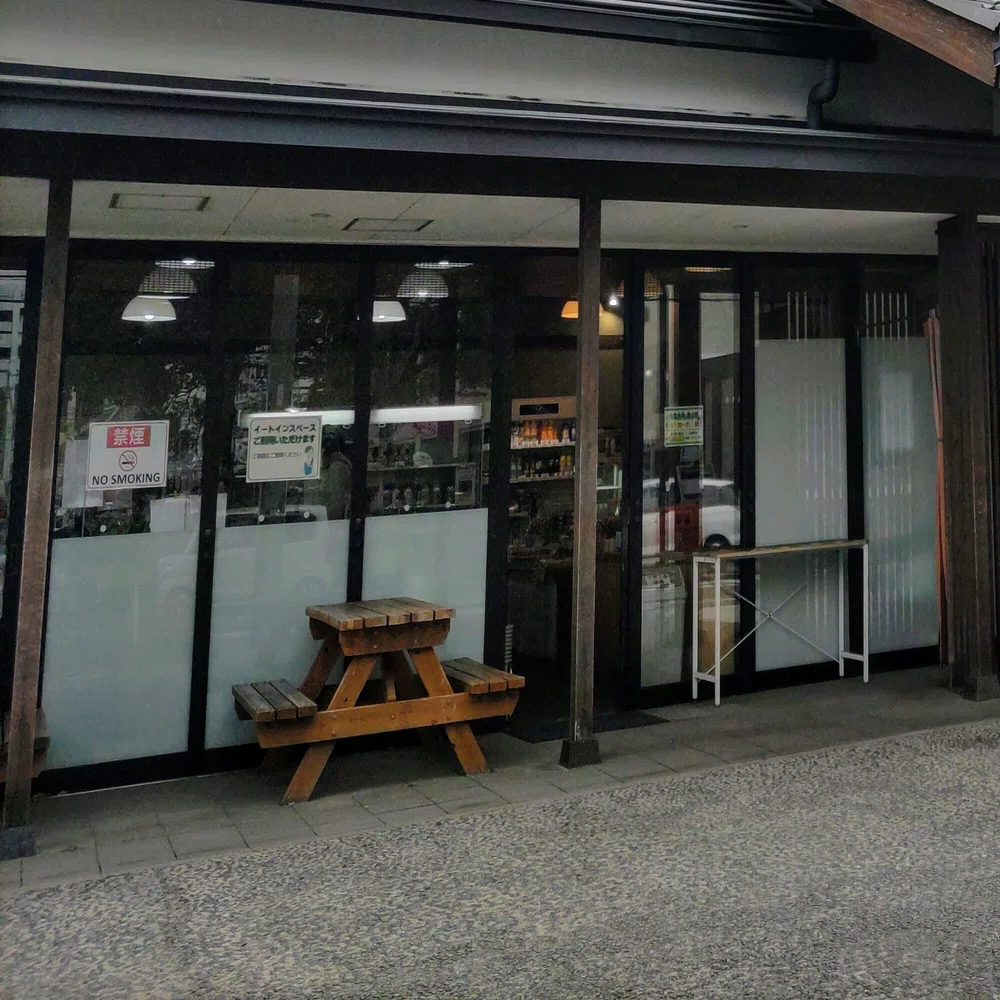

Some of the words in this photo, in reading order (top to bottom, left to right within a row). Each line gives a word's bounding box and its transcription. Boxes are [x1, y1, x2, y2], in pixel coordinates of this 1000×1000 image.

[254, 424, 317, 434] イートインスペース
[113, 427, 146, 446] 禁煙
[92, 475, 108, 486] NO
[111, 472, 161, 485] SMOKING
